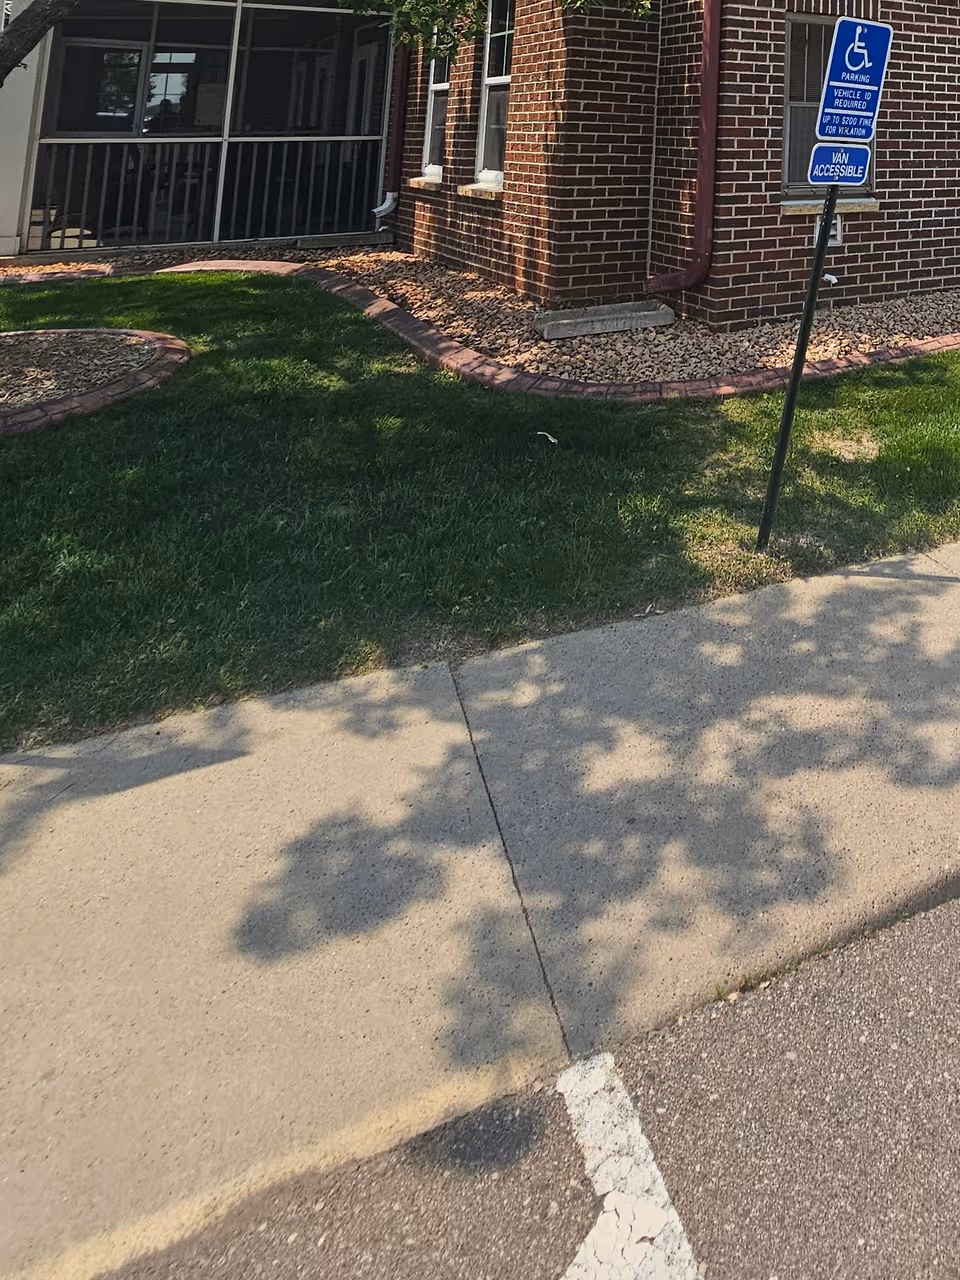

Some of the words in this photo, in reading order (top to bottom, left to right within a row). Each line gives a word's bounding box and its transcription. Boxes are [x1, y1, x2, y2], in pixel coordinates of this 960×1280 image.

[841, 72, 870, 83] PARKING
[834, 88, 861, 99] VEHICLE
[864, 92, 872, 100] ID
[834, 99, 867, 109] REQUIRED
[822, 115, 831, 123] UP
[832, 116, 840, 124] TO
[842, 116, 857, 125] $200
[825, 126, 836, 134] FOR
[838, 127, 866, 136] VILATION
[832, 152, 849, 164] VAN
[813, 164, 864, 177] ACCESSIBLE
